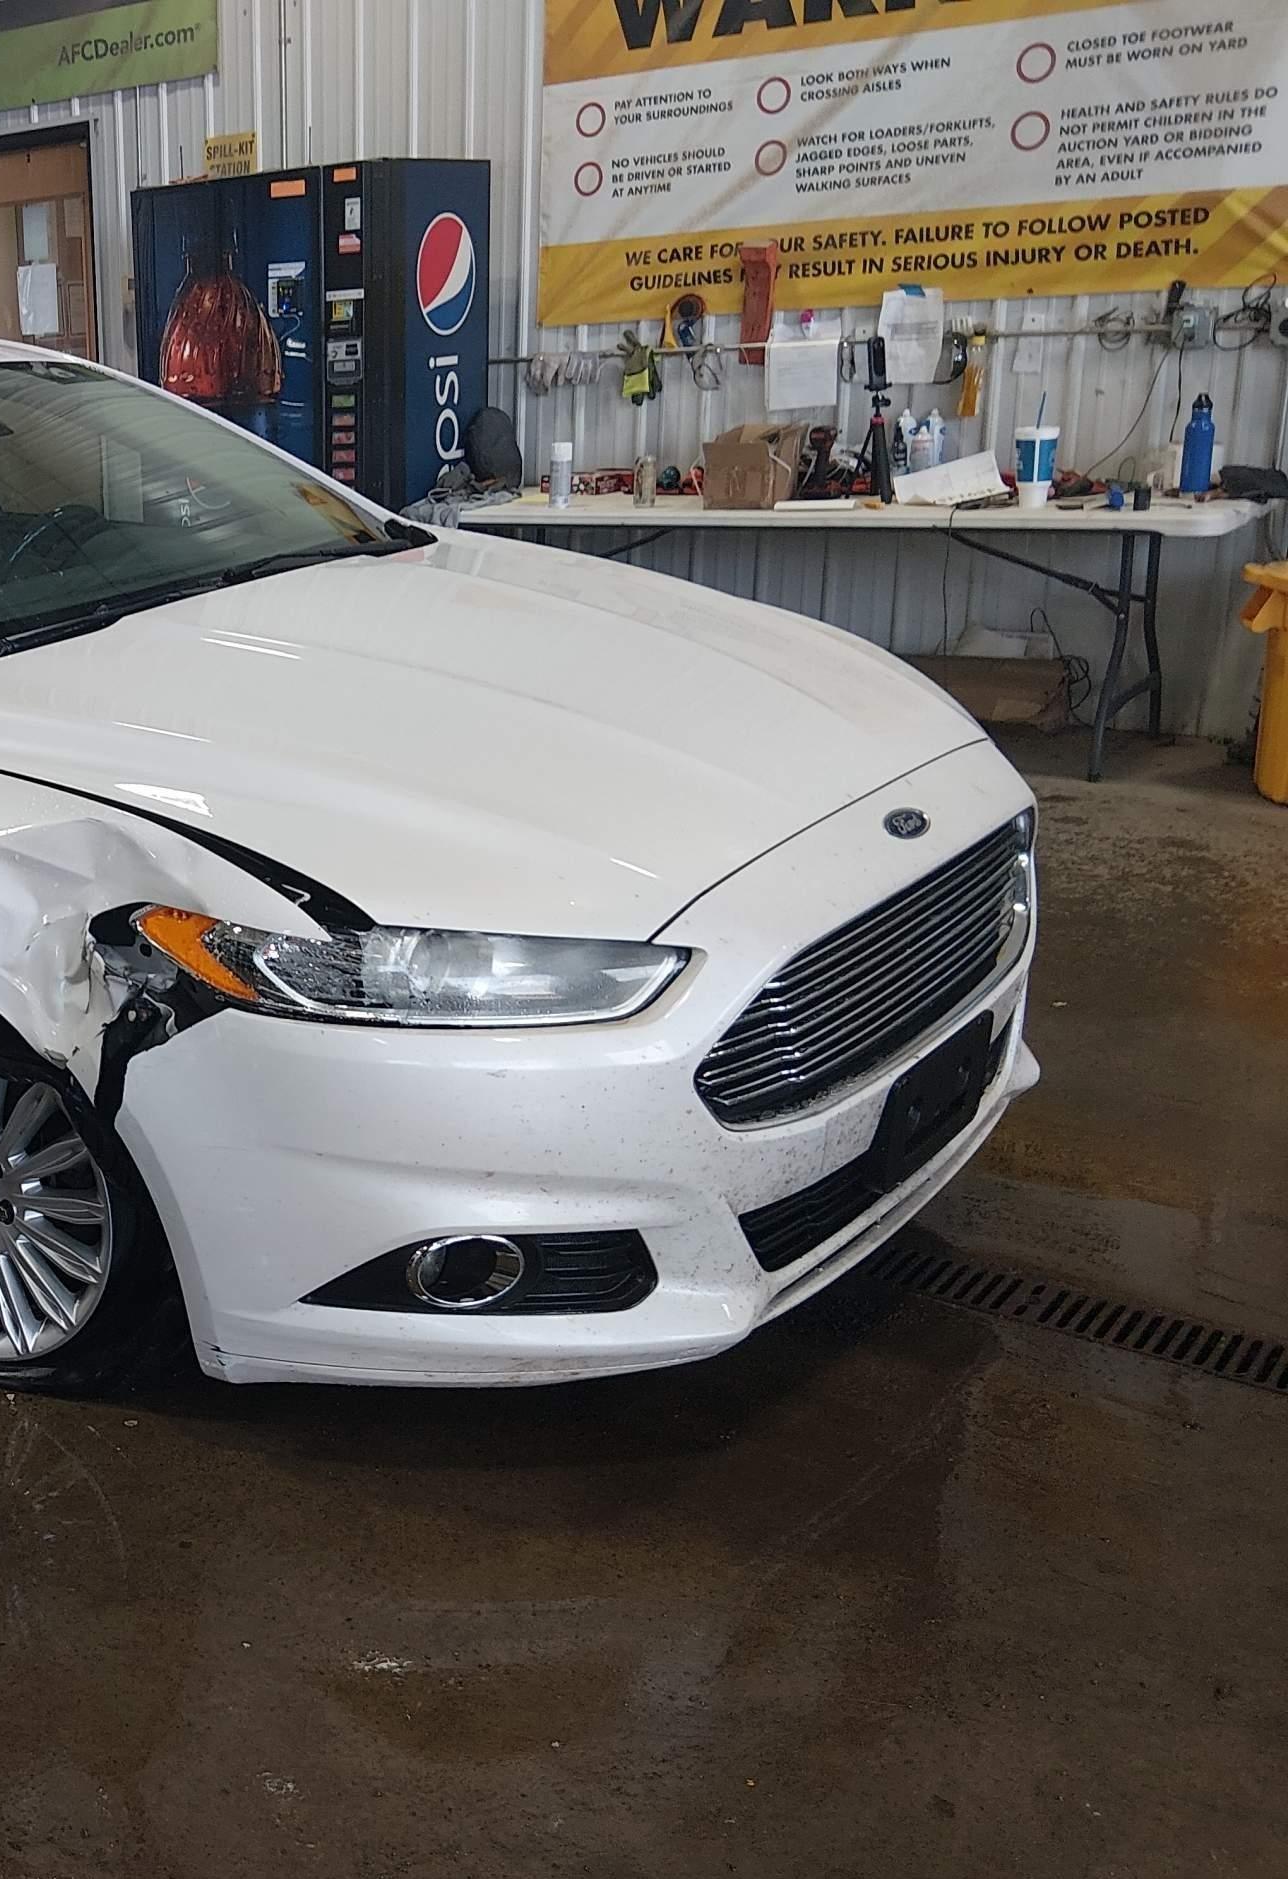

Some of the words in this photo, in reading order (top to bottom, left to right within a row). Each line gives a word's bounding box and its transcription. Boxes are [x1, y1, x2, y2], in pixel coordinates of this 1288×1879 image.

[1067, 35, 1117, 53] CLOSED
[1122, 31, 1146, 46] TOE
[1151, 21, 1234, 42] FOOTWEAR
[1065, 54, 1104, 70] MUST
[1106, 52, 1122, 65] BE
[1126, 45, 1175, 62] WORN
[1178, 43, 1203, 57] ON
[1208, 37, 1248, 52] YARD
[800, 73, 834, 87] LOOK
[838, 67, 870, 81] BOTH
[872, 62, 907, 77] WAYS
[910, 57, 951, 72] WHEN
[614, 100, 633, 111] PAY
[635, 91, 693, 107] ATTENTION
[697, 88, 712, 99] TO
[800, 85, 859, 102] CROSSING
[862, 79, 902, 93] AISLES
[1060, 104, 1111, 120] HEALTH
[1115, 100, 1146, 114] AND
[1150, 94, 1201, 111] SAFETY
[1205, 89, 1249, 105] RULES
[1254, 86, 1279, 99] DO
[614, 113, 642, 125] YOUR
[646, 100, 733, 121] SURROUNDINGS
[1059, 123, 1088, 137] NOT
[1092, 118, 1141, 134] PERMIT
[1143, 111, 1213, 129] CHILDREN
[1218, 108, 1235, 120] IN
[1240, 105, 1267, 118] THE
[797, 134, 837, 148] WATCH
[841, 130, 865, 143] FOR
[869, 116, 996, 141] LOADERS/FORKLIFTS,
[1057, 138, 1118, 154] AUCTION
[1123, 133, 1159, 147] YARD
[1164, 130, 1184, 144] OR
[1189, 124, 1253, 141] BIDDING
[206, 139, 255, 160] SPILL-KIT
[612, 158, 630, 169] NO
[633, 152, 678, 166] VEHICLES
[682, 147, 725, 161] SHOULD
[795, 148, 843, 163] JAGGED
[847, 144, 887, 158] EDGES,
[891, 139, 929, 154] LOOSE
[933, 136, 974, 149] PARTS,
[1056, 155, 1095, 170] AREA,
[1099, 151, 1135, 166] EVEN
[1139, 150, 1150, 163] IF
[1154, 141, 1263, 161] ACCOMPANIED
[612, 174, 624, 183] BE
[627, 169, 665, 182] DRIVEN
[668, 166, 682, 177] OR
[686, 161, 731, 175] STARTED
[795, 165, 835, 179] SHARP
[839, 160, 882, 174] POINTS
[885, 157, 912, 170] AND
[916, 152, 966, 166] UNEVEN
[1054, 174, 1071, 187] BY
[1075, 172, 1096, 185] AN
[1100, 168, 1143, 183] ADULT
[612, 188, 624, 198] AT
[627, 183, 671, 196] ANYTIME
[795, 177, 851, 194] WALKING
[855, 173, 911, 188] SURFACES
[625, 251, 651, 267] WE
[657, 245, 703, 263] CARE
[812, 229, 887, 251] SAFETY.
[894, 223, 974, 245] FAILURE
[982, 221, 1010, 239] TO
[1017, 213, 1112, 236] FOLLOW
[1118, 206, 1210, 230] POSTED
[629, 268, 733, 291] GUIDELINES
[788, 259, 855, 279] RESULT
[862, 257, 884, 274] IN
[891, 251, 978, 273] SERIOUS
[985, 245, 1066, 267] INJURY
[1074, 243, 1107, 261] OR
[1115, 238, 1199, 260] DEATH.
[429, 355, 465, 482] psi
